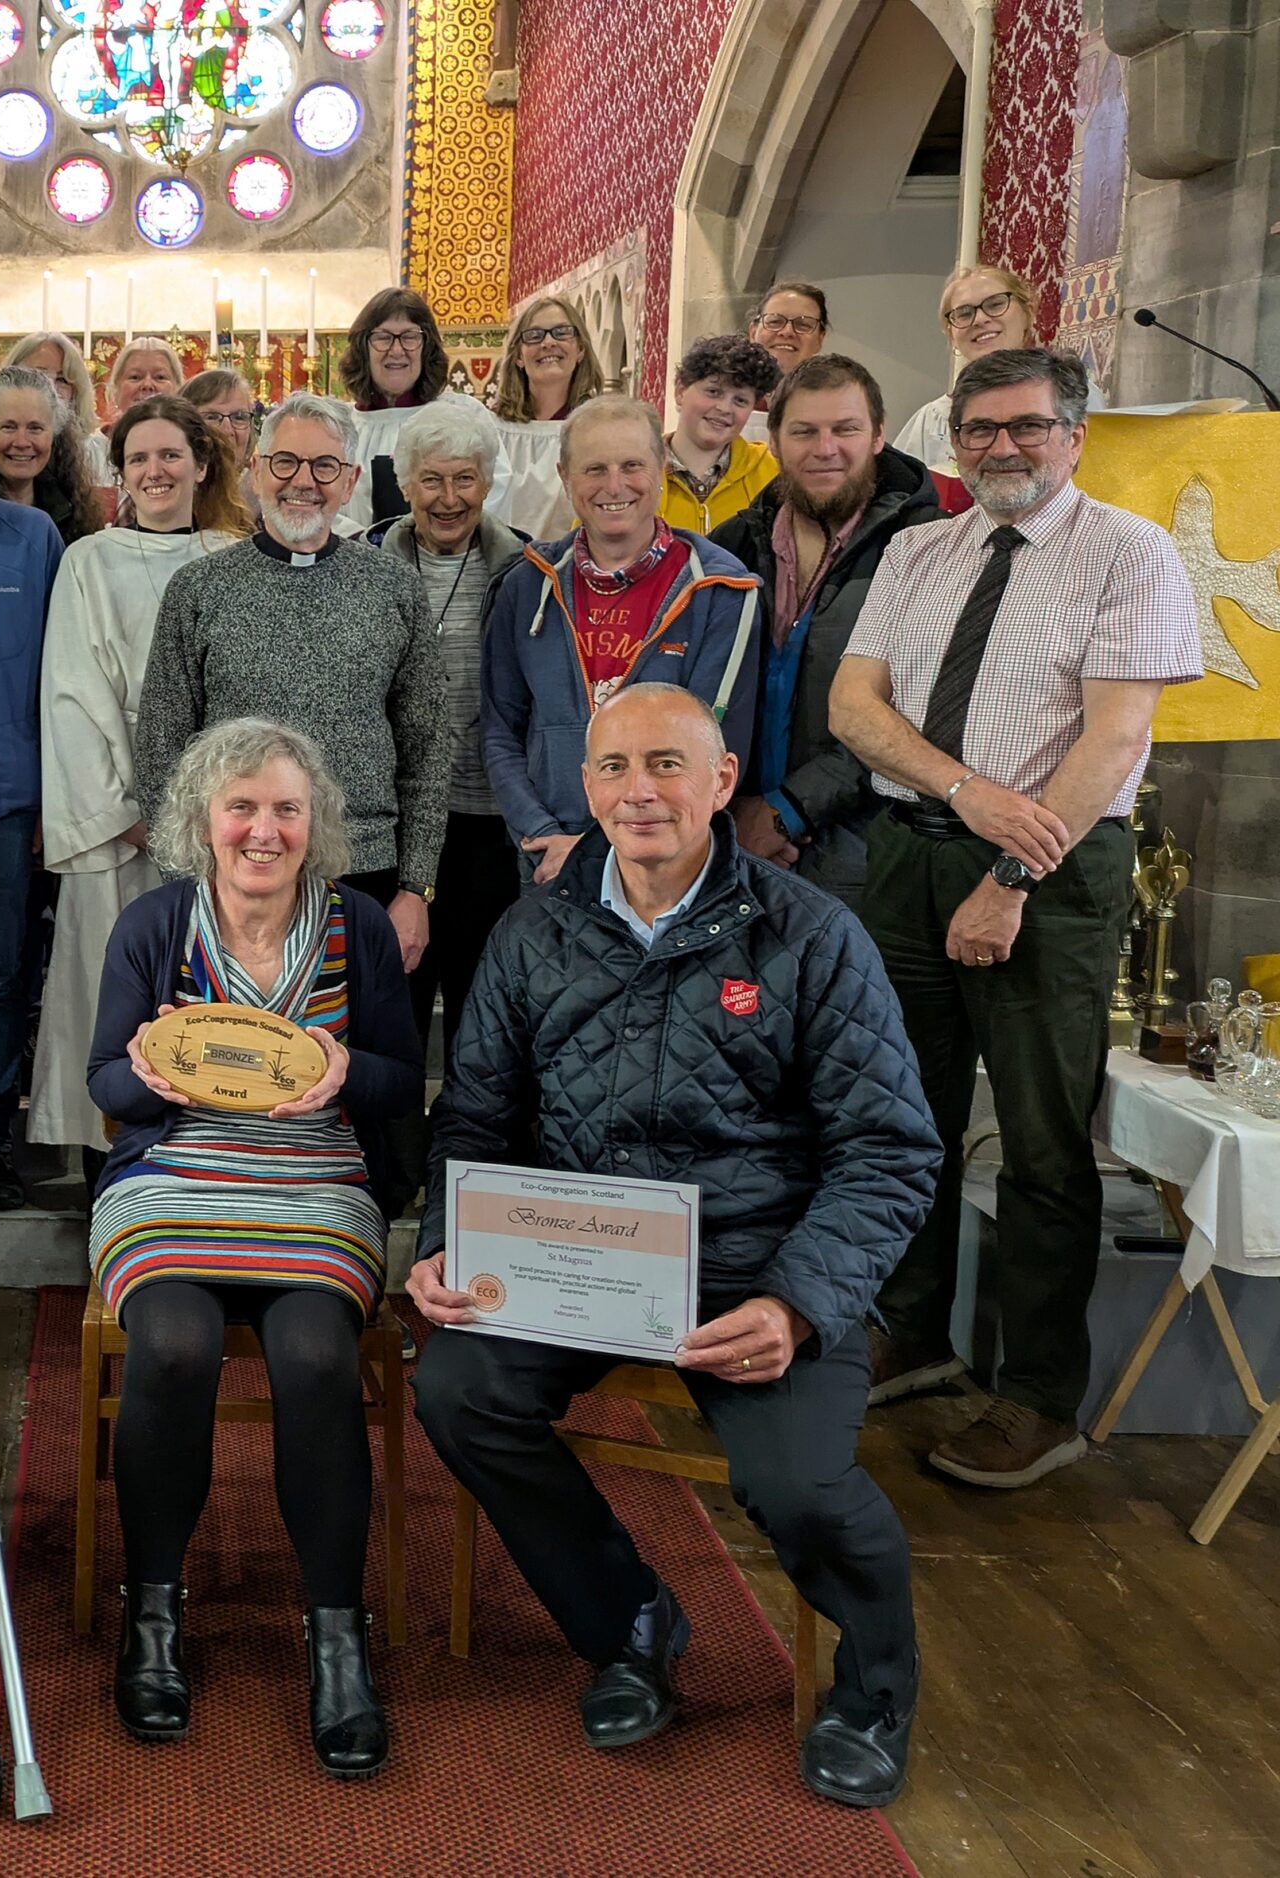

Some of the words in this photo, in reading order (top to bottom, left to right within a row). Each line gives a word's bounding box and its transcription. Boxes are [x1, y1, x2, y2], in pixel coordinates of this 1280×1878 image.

[589, 608, 630, 625] THE
[734, 999, 753, 1011] ARMY
[185, 1015, 257, 1027] Eco-Congregation
[258, 1021, 294, 1040] Scotland
[210, 1048, 255, 1064] BRONZE
[181, 1060, 197, 1069] eco
[280, 1075, 296, 1085] eco
[211, 1085, 247, 1099] Award
[521, 1181, 588, 1196] Eco-Congregation
[591, 1189, 624, 1200] Scotland
[507, 1207, 576, 1230] Bronze
[578, 1215, 639, 1238] Award
[547, 1253, 556, 1261] St
[558, 1254, 593, 1266] Magnus
[519, 1265, 533, 1273] good
[534, 1267, 556, 1276] practice
[563, 1271, 581, 1280] caring
[591, 1275, 615, 1283] creation
[476, 1287, 498, 1299] ECO
[562, 1280, 586, 1288] practical
[618, 1286, 636, 1295] global
